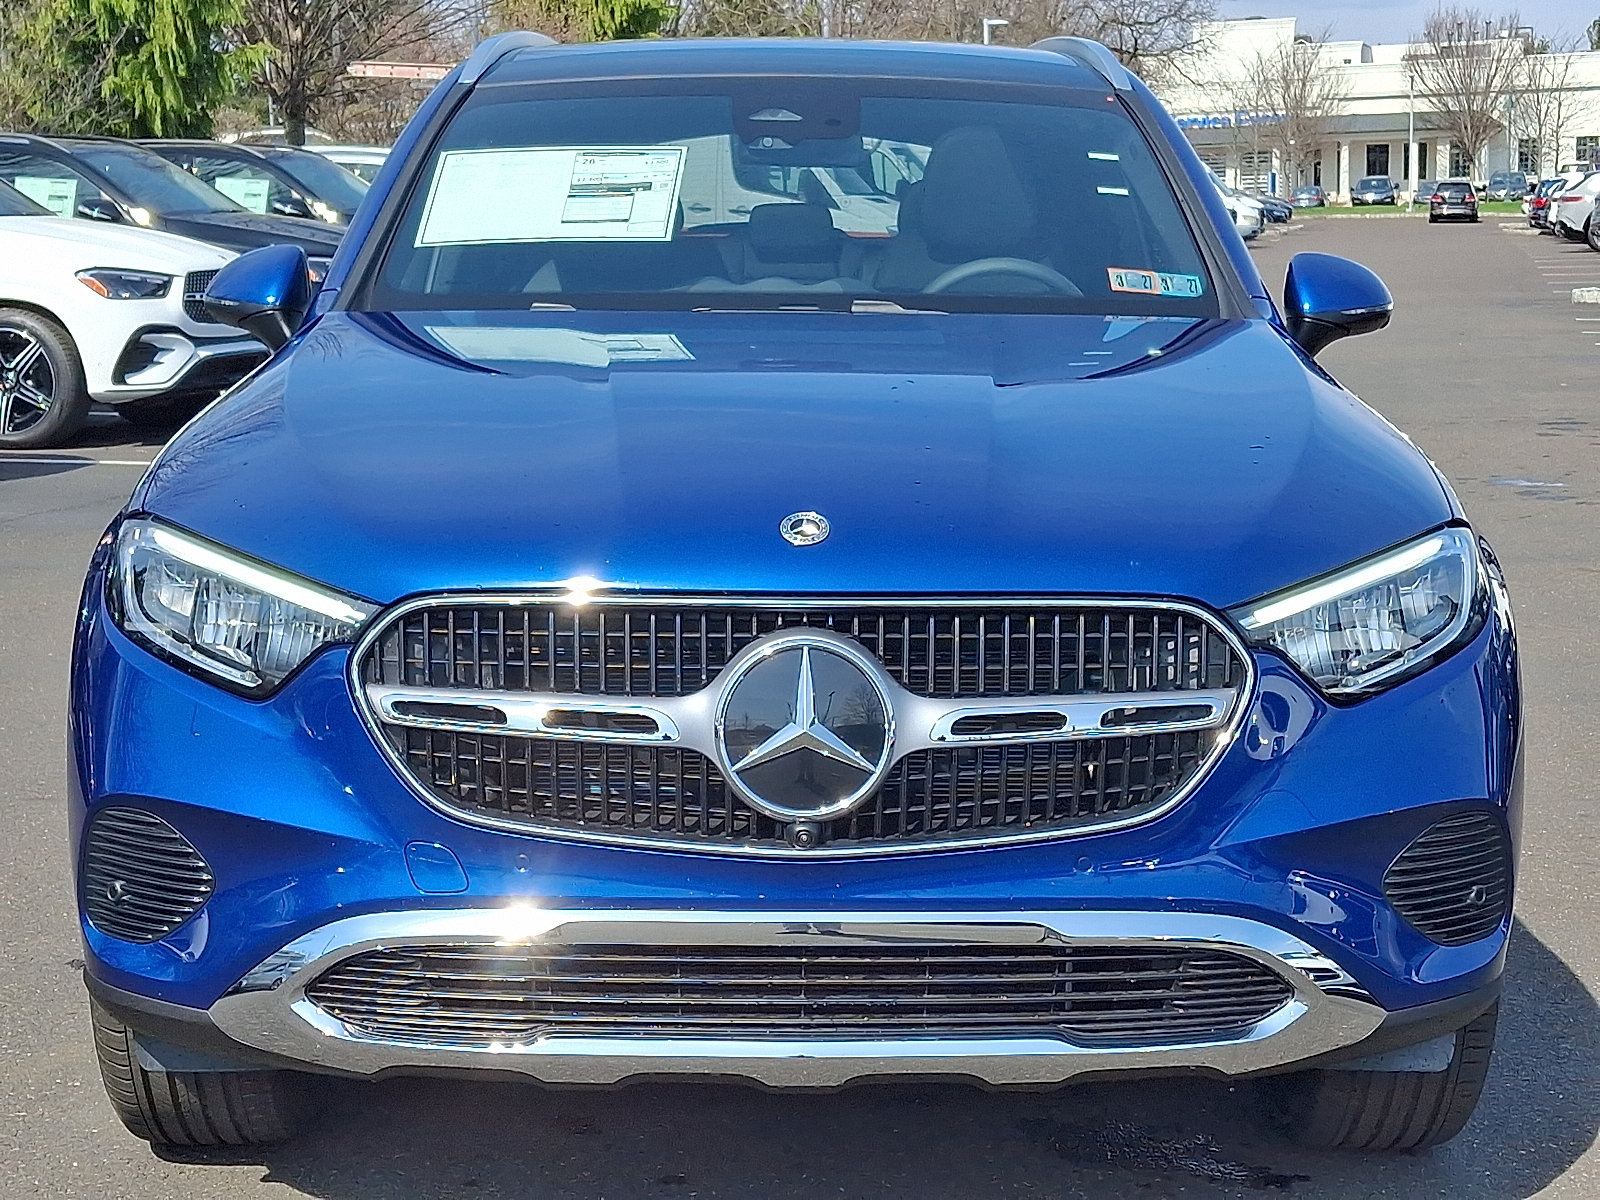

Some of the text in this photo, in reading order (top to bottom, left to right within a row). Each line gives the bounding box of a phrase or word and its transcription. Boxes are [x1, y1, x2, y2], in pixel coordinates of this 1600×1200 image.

[1115, 274, 1153, 290] 3 27
[1186, 278, 1198, 294] 27
